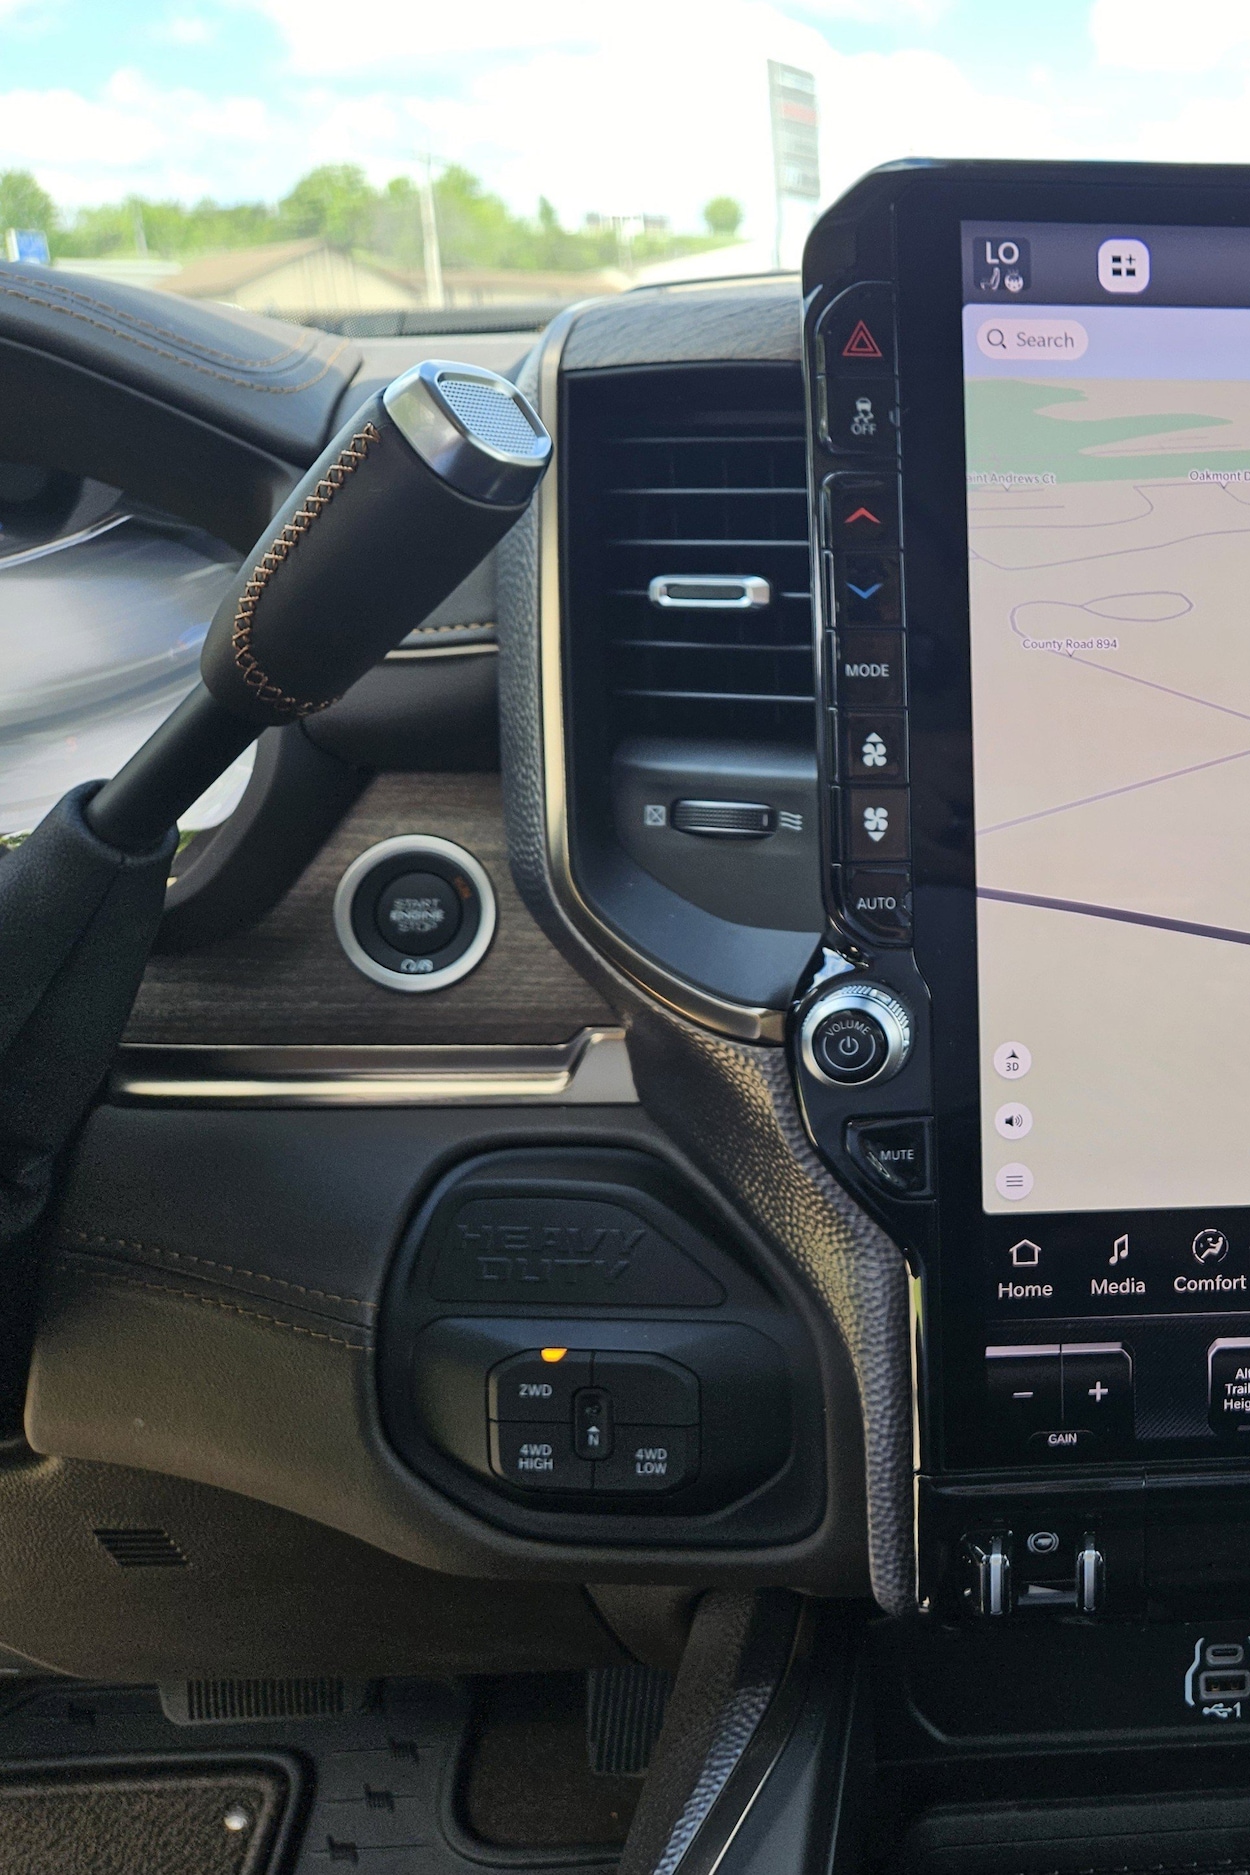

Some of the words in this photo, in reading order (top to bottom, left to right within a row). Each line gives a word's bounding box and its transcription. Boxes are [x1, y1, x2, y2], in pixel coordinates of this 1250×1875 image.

[985, 241, 1020, 264] LO
[1016, 331, 1075, 349] Search
[851, 424, 877, 435] OFF
[991, 472, 1040, 484] Andrews
[1042, 473, 1055, 484] Ct
[1189, 471, 1241, 482] Oakmont
[1022, 639, 1063, 651] County
[1066, 639, 1094, 649] Road
[1096, 639, 1118, 649] 894
[845, 664, 890, 678] MODE
[857, 897, 896, 911] AUTO
[825, 1020, 871, 1036] VOLUME
[1005, 1062, 1019, 1072] 3D
[880, 1149, 914, 1162] MUTE
[457, 1223, 647, 1256] HEAVY
[475, 1255, 632, 1284] DUTY
[1091, 1277, 1146, 1295] Media
[1173, 1274, 1247, 1292] Comfort
[998, 1282, 1053, 1299] Home
[519, 1383, 553, 1397] 2WD
[587, 1433, 600, 1447] N
[1048, 1432, 1078, 1445] GAIN
[519, 1444, 553, 1458] 4WD
[635, 1448, 668, 1462] 4WD
[519, 1458, 554, 1472] HIGH
[636, 1462, 668, 1476] LOW
[1232, 1702, 1242, 1719] 1
